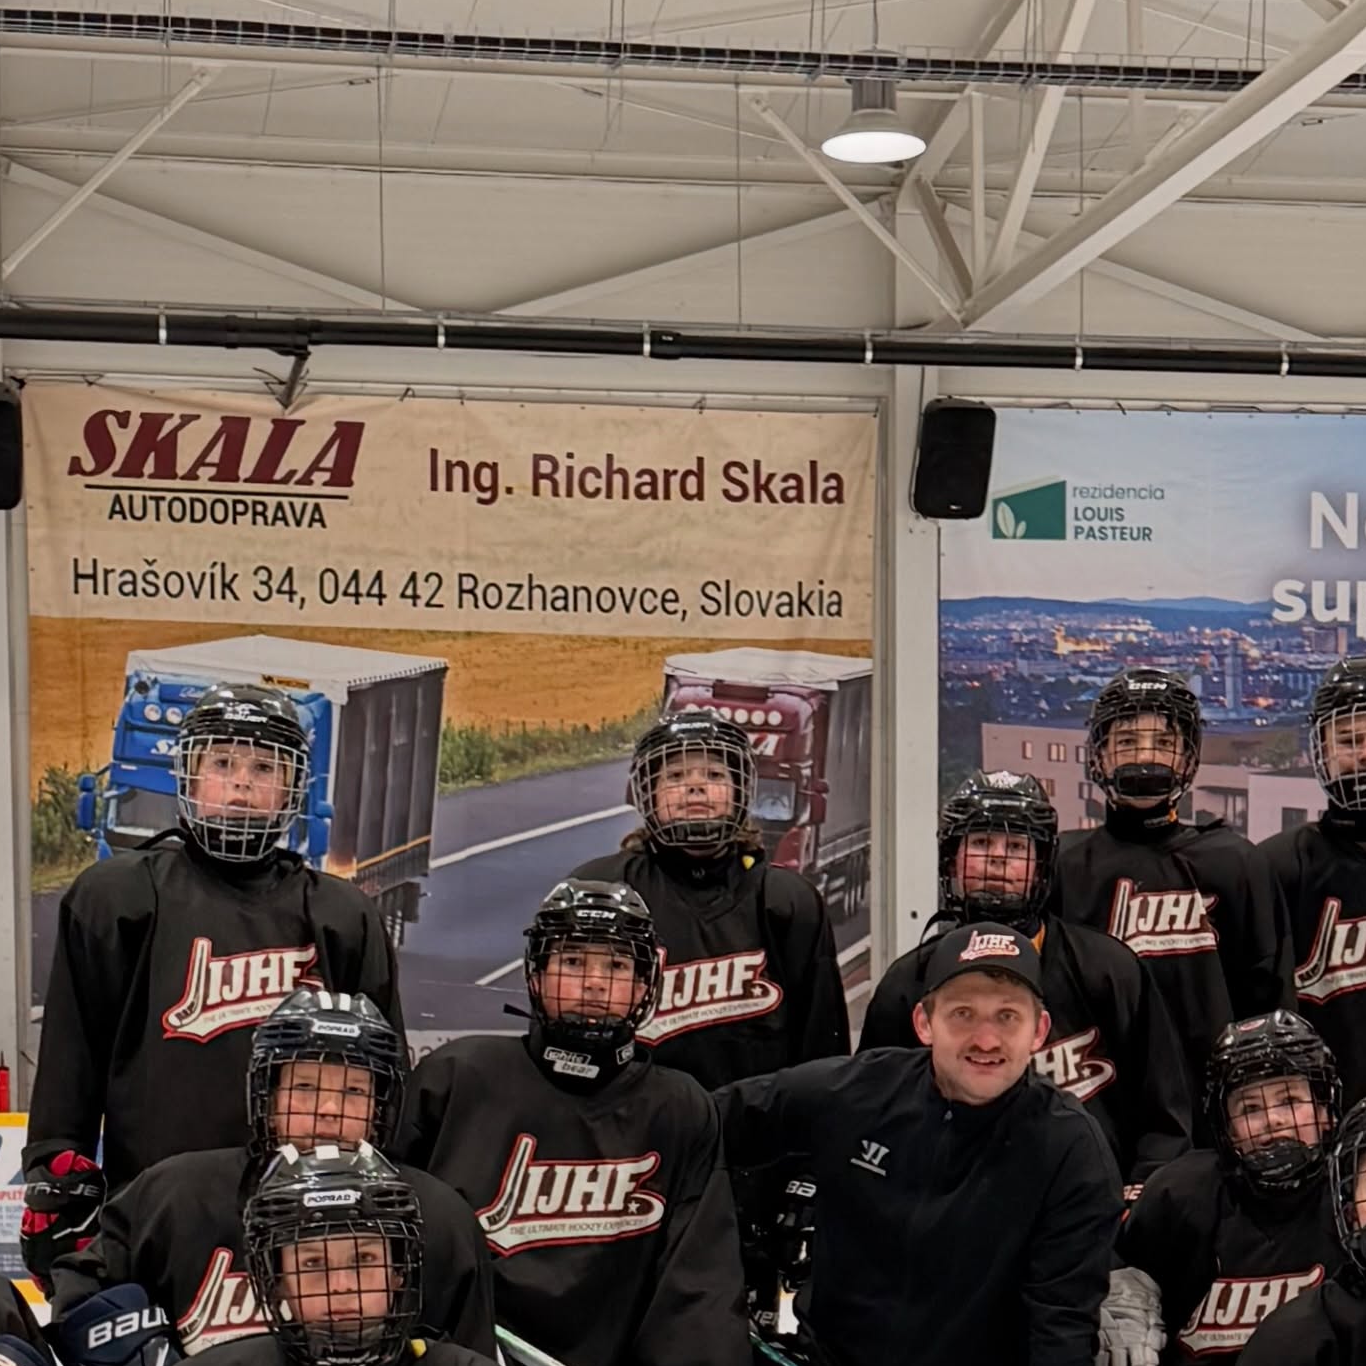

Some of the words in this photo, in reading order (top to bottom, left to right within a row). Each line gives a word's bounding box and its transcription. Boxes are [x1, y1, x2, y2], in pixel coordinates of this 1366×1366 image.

[68, 409, 365, 488] SKALA
[430, 448, 514, 505] Ing.
[532, 453, 706, 503] Richard
[721, 461, 845, 505] Skala
[1072, 482, 1165, 502] rezidencia
[108, 492, 327, 529] AUTODOPRAVA
[1073, 506, 1125, 523] LOUIS
[1073, 524, 1153, 542] PASTEUR
[72, 557, 240, 602] Hrašovík
[252, 568, 307, 609] 34,
[318, 569, 386, 607] 044
[400, 571, 444, 610] 42
[458, 573, 687, 621] Rozhanovce,
[699, 581, 844, 619] Slovakia
[577, 909, 616, 920] CCM
[207, 947, 315, 1006] IJHF
[659, 951, 765, 1011] IJHF
[306, 1194, 352, 1204] POPRAD
[517, 1154, 656, 1216] IJHF
